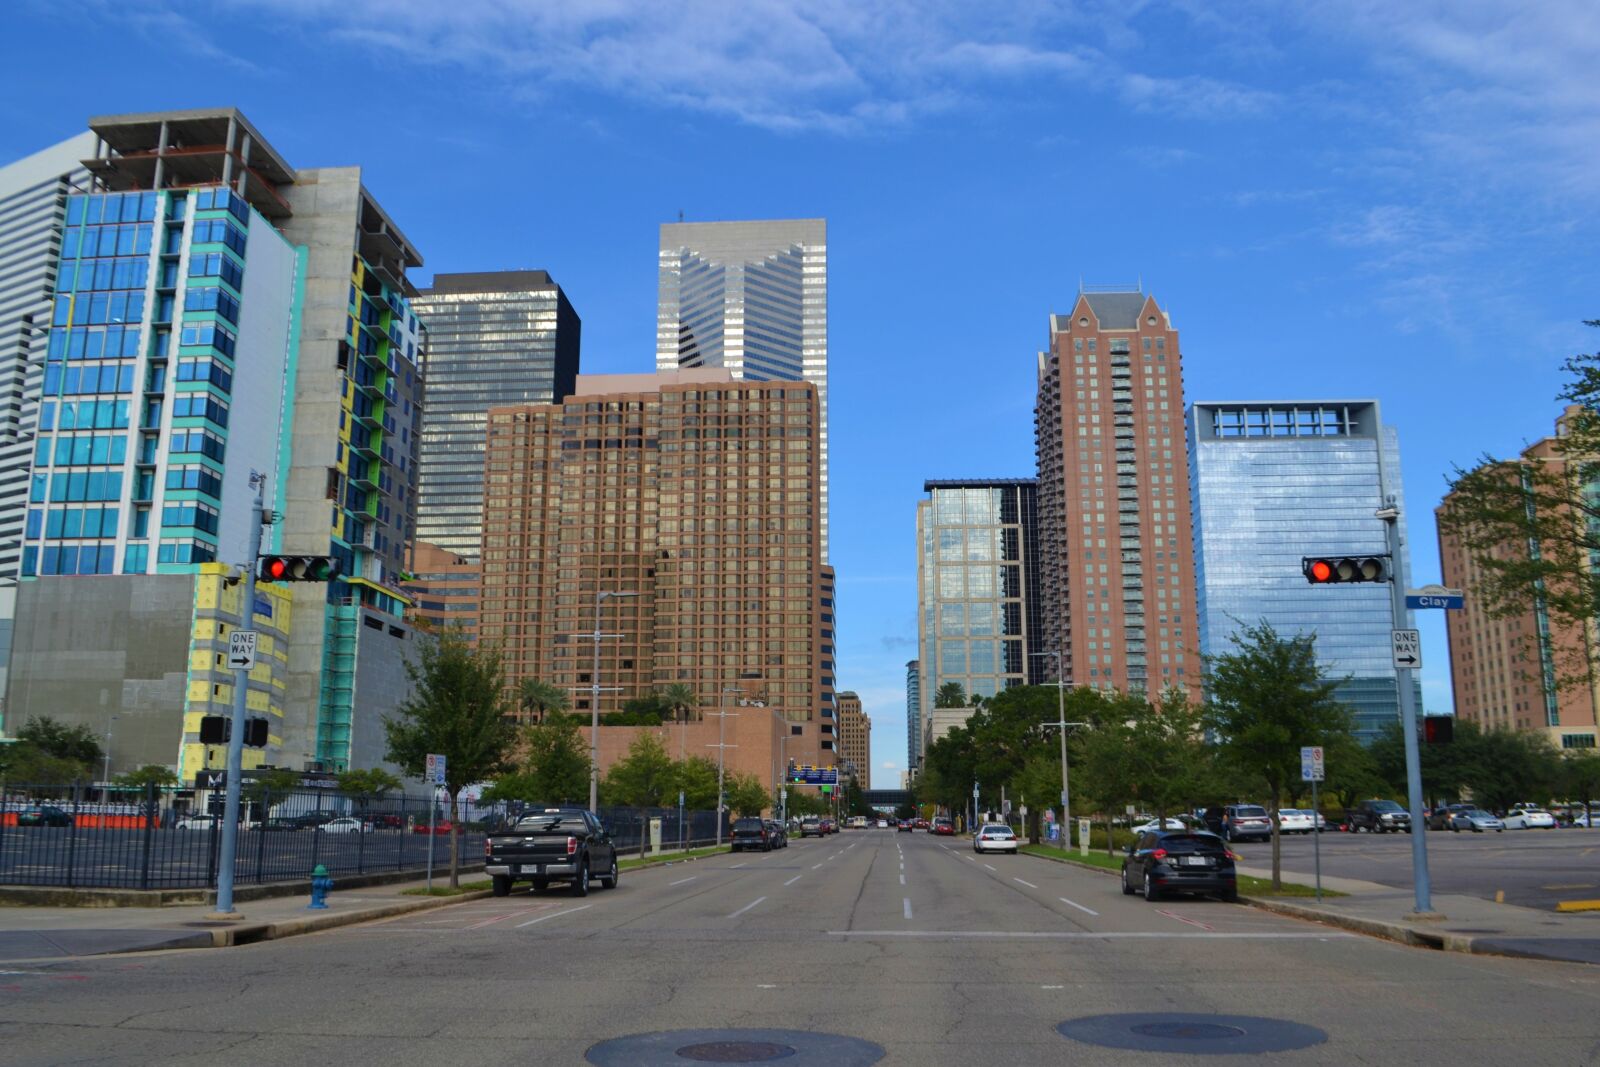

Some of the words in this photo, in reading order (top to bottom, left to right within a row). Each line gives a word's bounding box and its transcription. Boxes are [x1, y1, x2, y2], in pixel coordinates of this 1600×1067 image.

[1419, 597, 1448, 608] Clay
[232, 633, 255, 643] ONE
[1395, 632, 1417, 642] ONE
[231, 644, 254, 654] WAY
[1395, 643, 1418, 653] WAY
